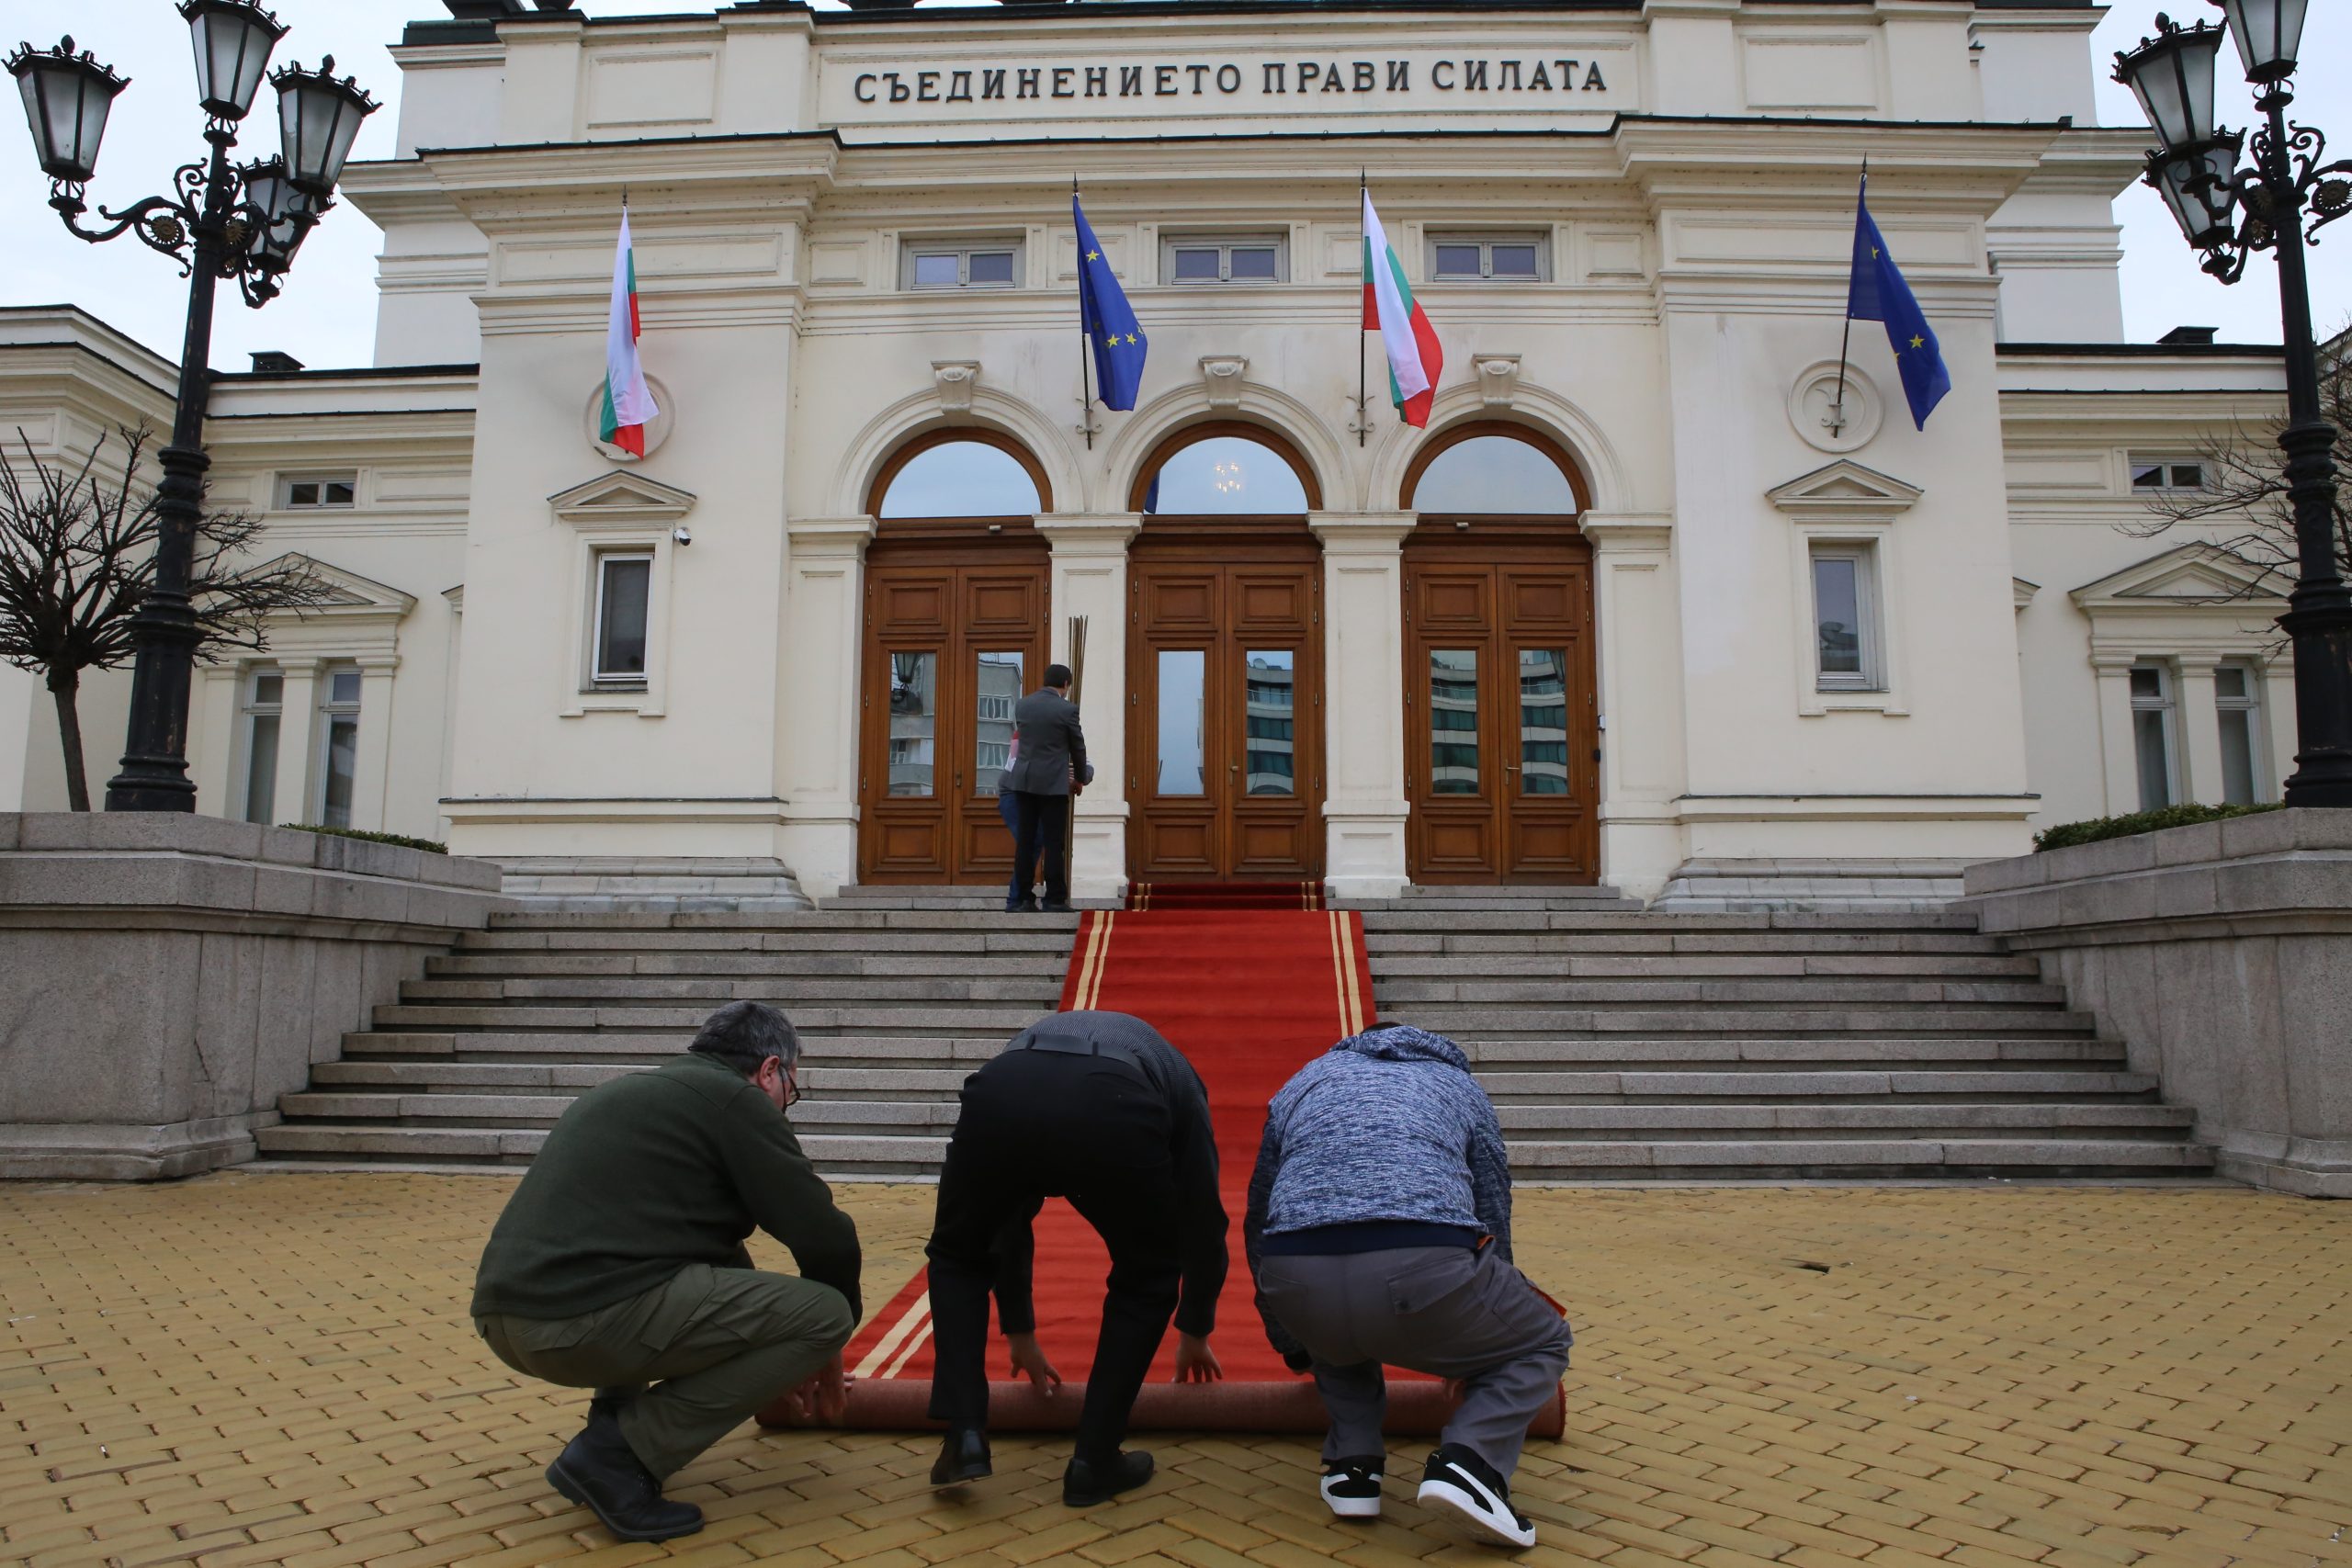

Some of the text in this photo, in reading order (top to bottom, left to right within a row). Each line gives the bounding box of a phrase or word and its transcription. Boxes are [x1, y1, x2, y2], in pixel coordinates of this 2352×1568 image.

[854, 60, 1607, 105] СЪЕДИНЕНИЕТО ПРАВИ СИЛАТА
